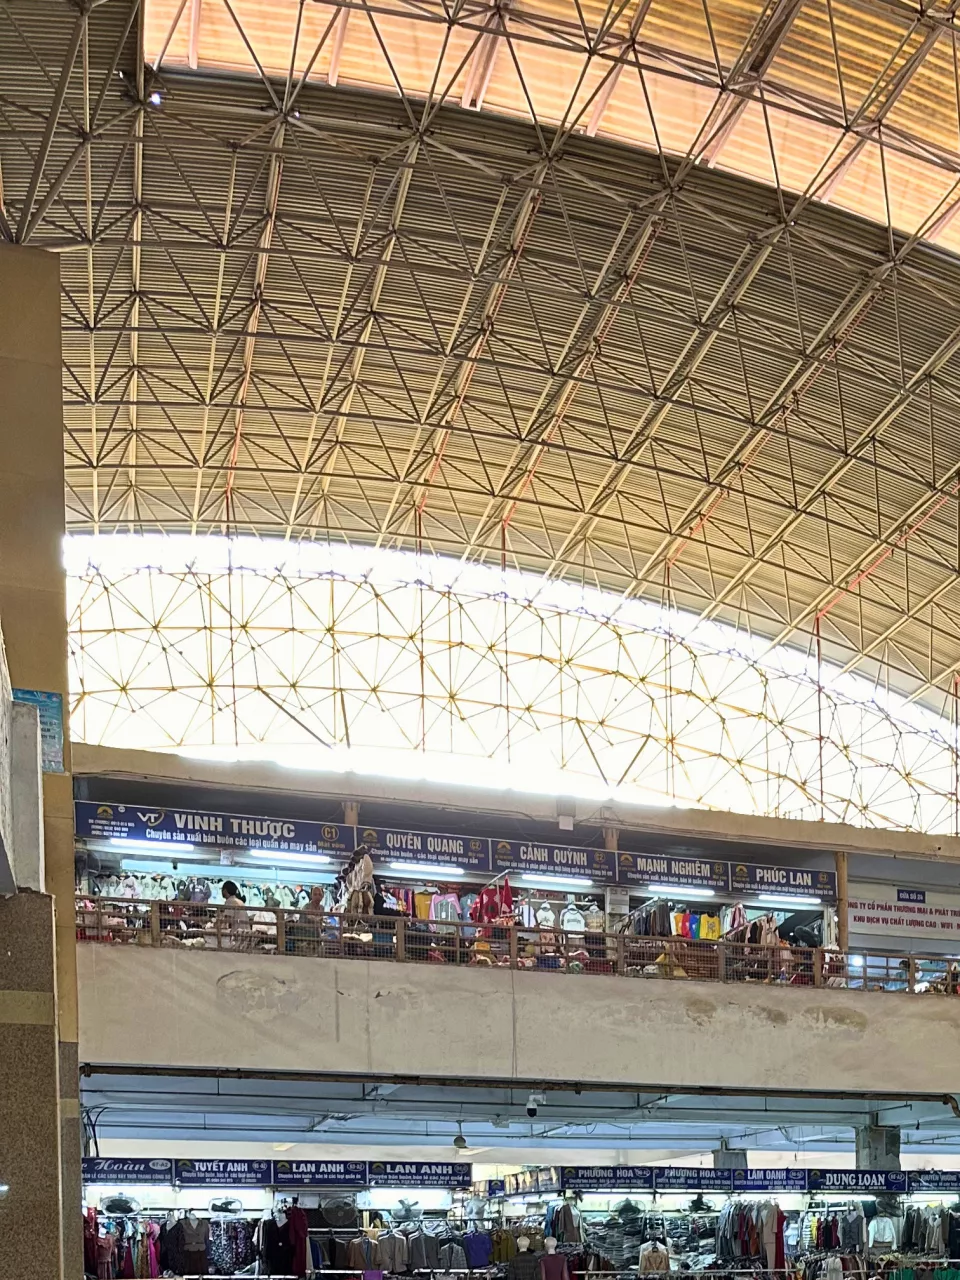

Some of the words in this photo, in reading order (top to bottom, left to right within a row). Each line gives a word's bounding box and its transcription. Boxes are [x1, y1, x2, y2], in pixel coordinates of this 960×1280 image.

[137, 812, 159, 823] VT
[174, 813, 223, 832] VINH
[230, 818, 296, 839] THƯỢC
[324, 827, 336, 839] C1
[146, 828, 171, 840] Chuyên
[203, 833, 215, 844] bán
[217, 834, 234, 845] buôn
[235, 836, 248, 845] các
[249, 837, 262, 848] loại
[290, 842, 304, 852] may
[386, 833, 421, 850] QUYÊN
[427, 837, 464, 854] QUANG
[520, 842, 549, 862] CẢNH
[553, 848, 587, 866] QUỲNH
[637, 857, 667, 873] MẠNH
[671, 860, 710, 877] NGHIÊM
[756, 867, 786, 884] PHÚC
[789, 872, 811, 886] LAN
[853, 915, 865, 923] KHU
[94, 1159, 145, 1171] Hoàn
[194, 1160, 225, 1171] TUYẾT
[227, 1162, 248, 1172] ANH
[292, 1163, 316, 1173] LAN
[319, 1163, 344, 1172] ANH
[386, 1164, 416, 1173] LAN
[420, 1165, 453, 1174] ANH
[617, 1169, 634, 1178] HOA
[700, 1170, 715, 1178] HOA
[748, 1169, 764, 1180] LÂM
[766, 1170, 787, 1180] OANH
[826, 1173, 857, 1186] DUNG
[858, 1174, 885, 1186] LOAN
